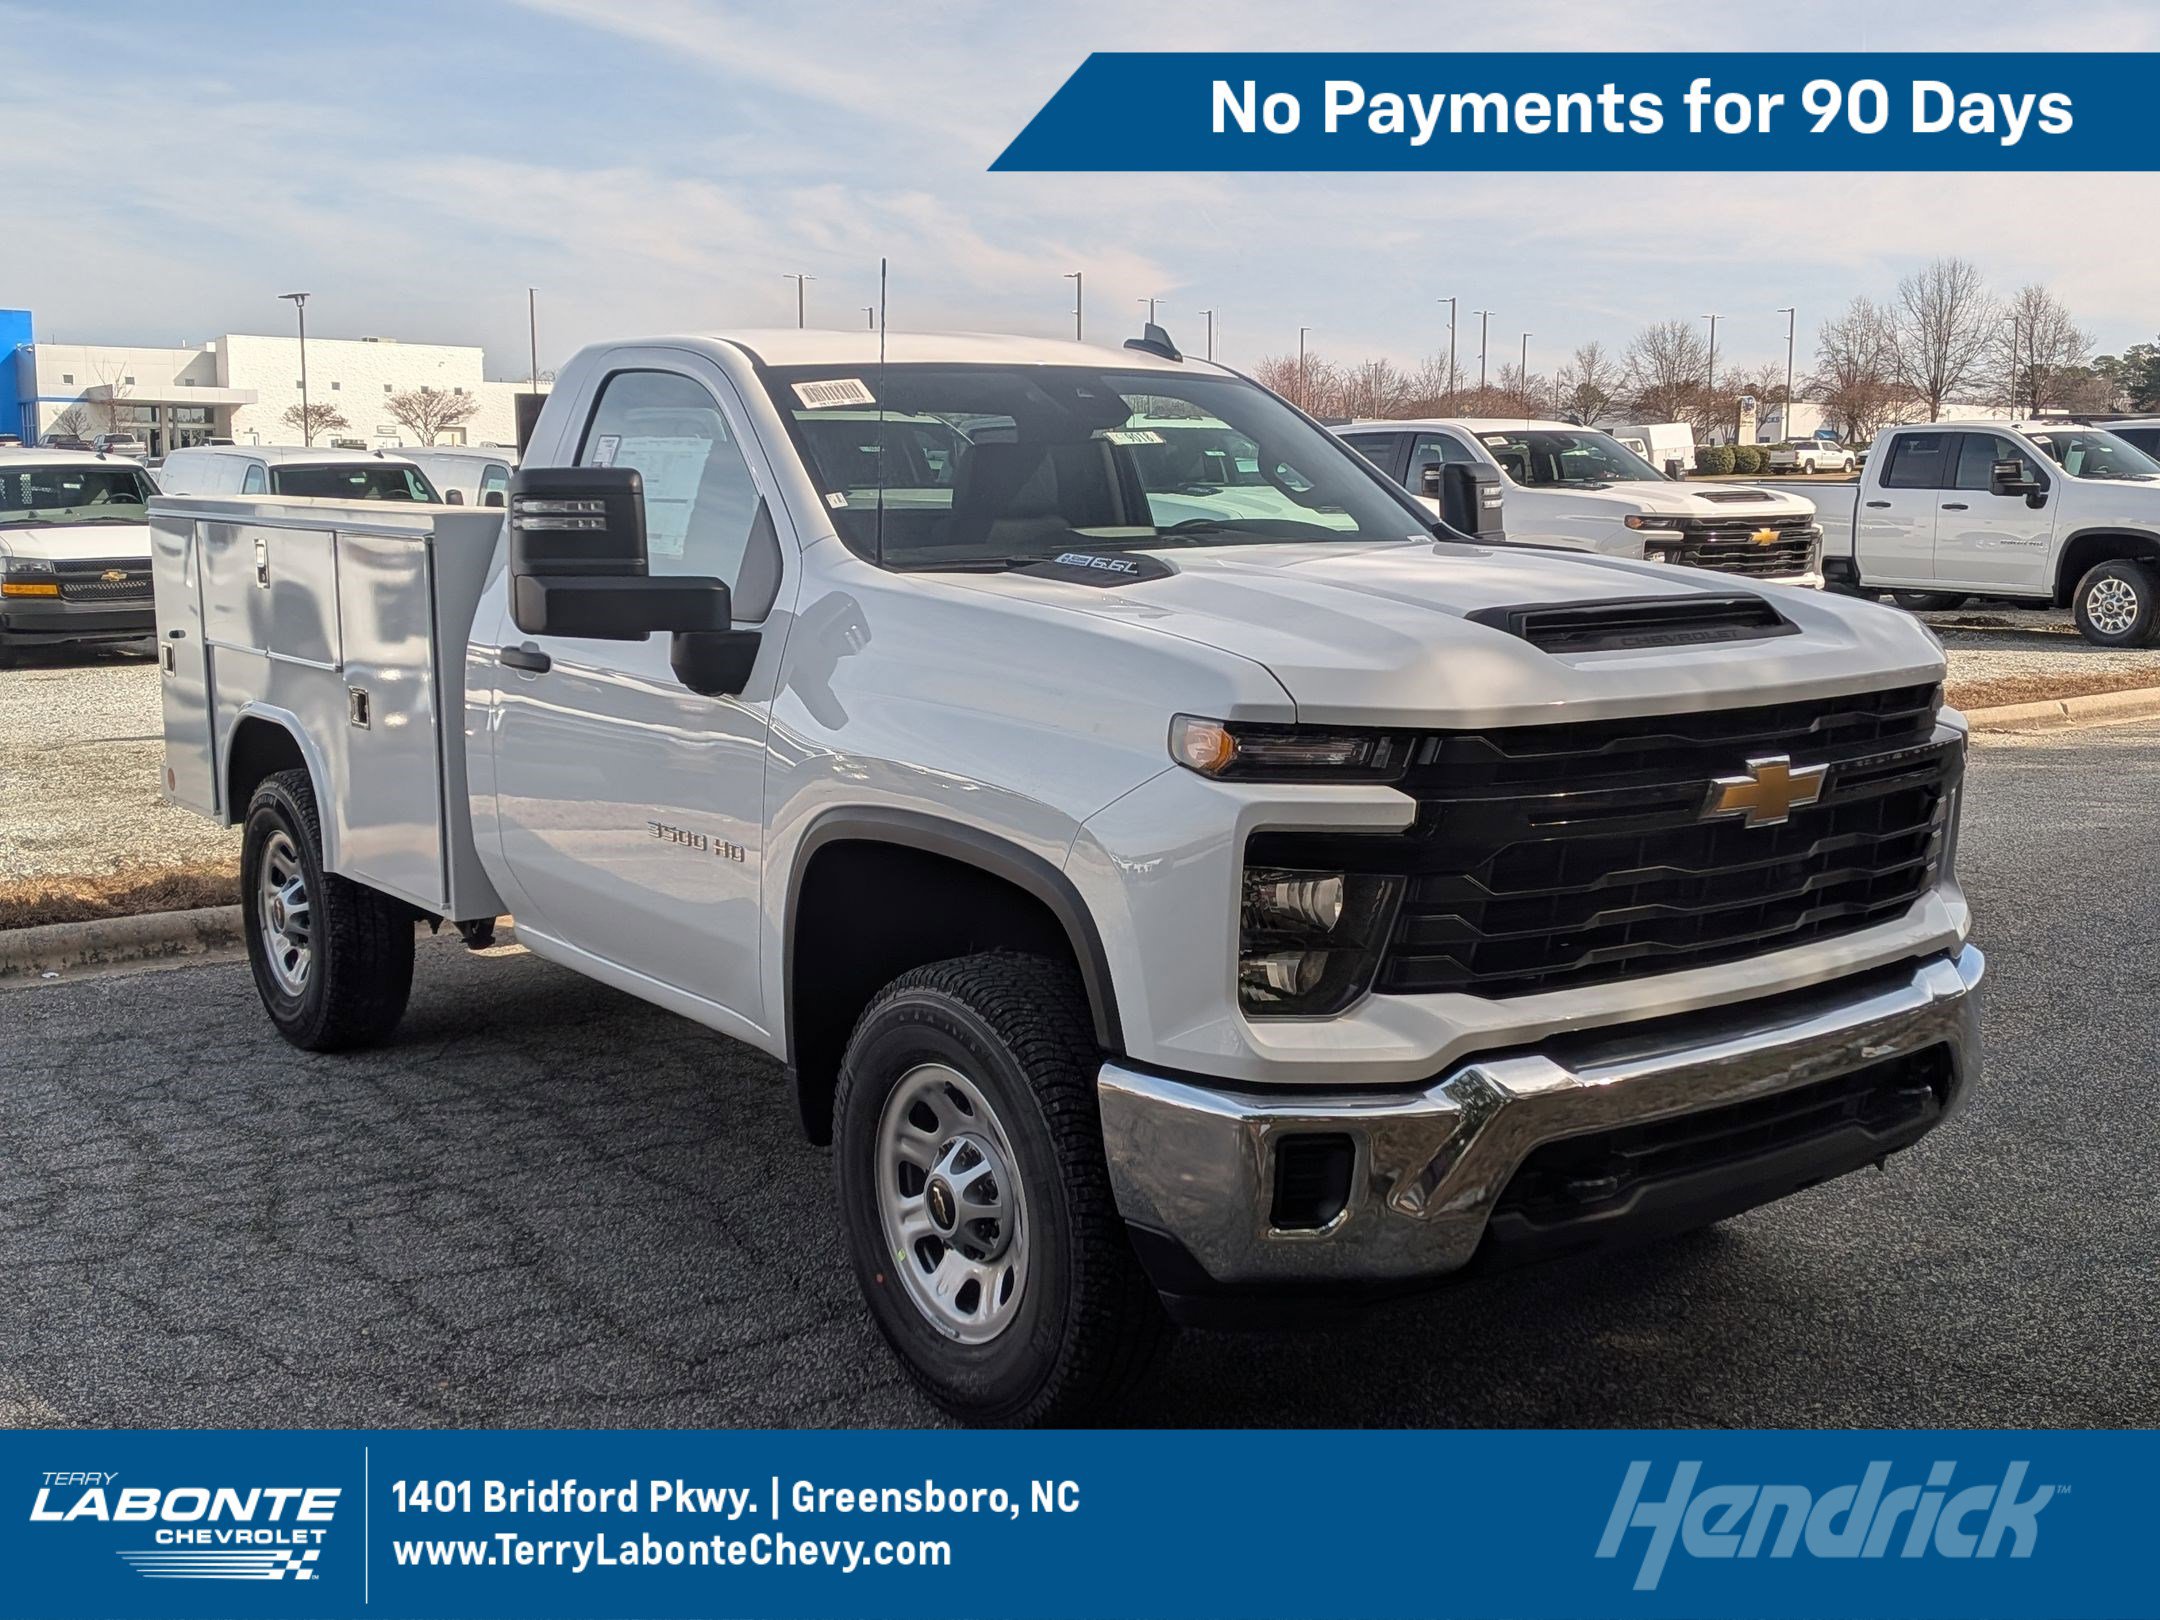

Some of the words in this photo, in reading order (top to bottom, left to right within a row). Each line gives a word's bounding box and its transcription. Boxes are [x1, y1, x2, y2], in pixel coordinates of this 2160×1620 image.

[1622, 629, 1737, 646] CHEVROLET
[647, 820, 708, 851] 3500
[712, 837, 746, 863] HD
